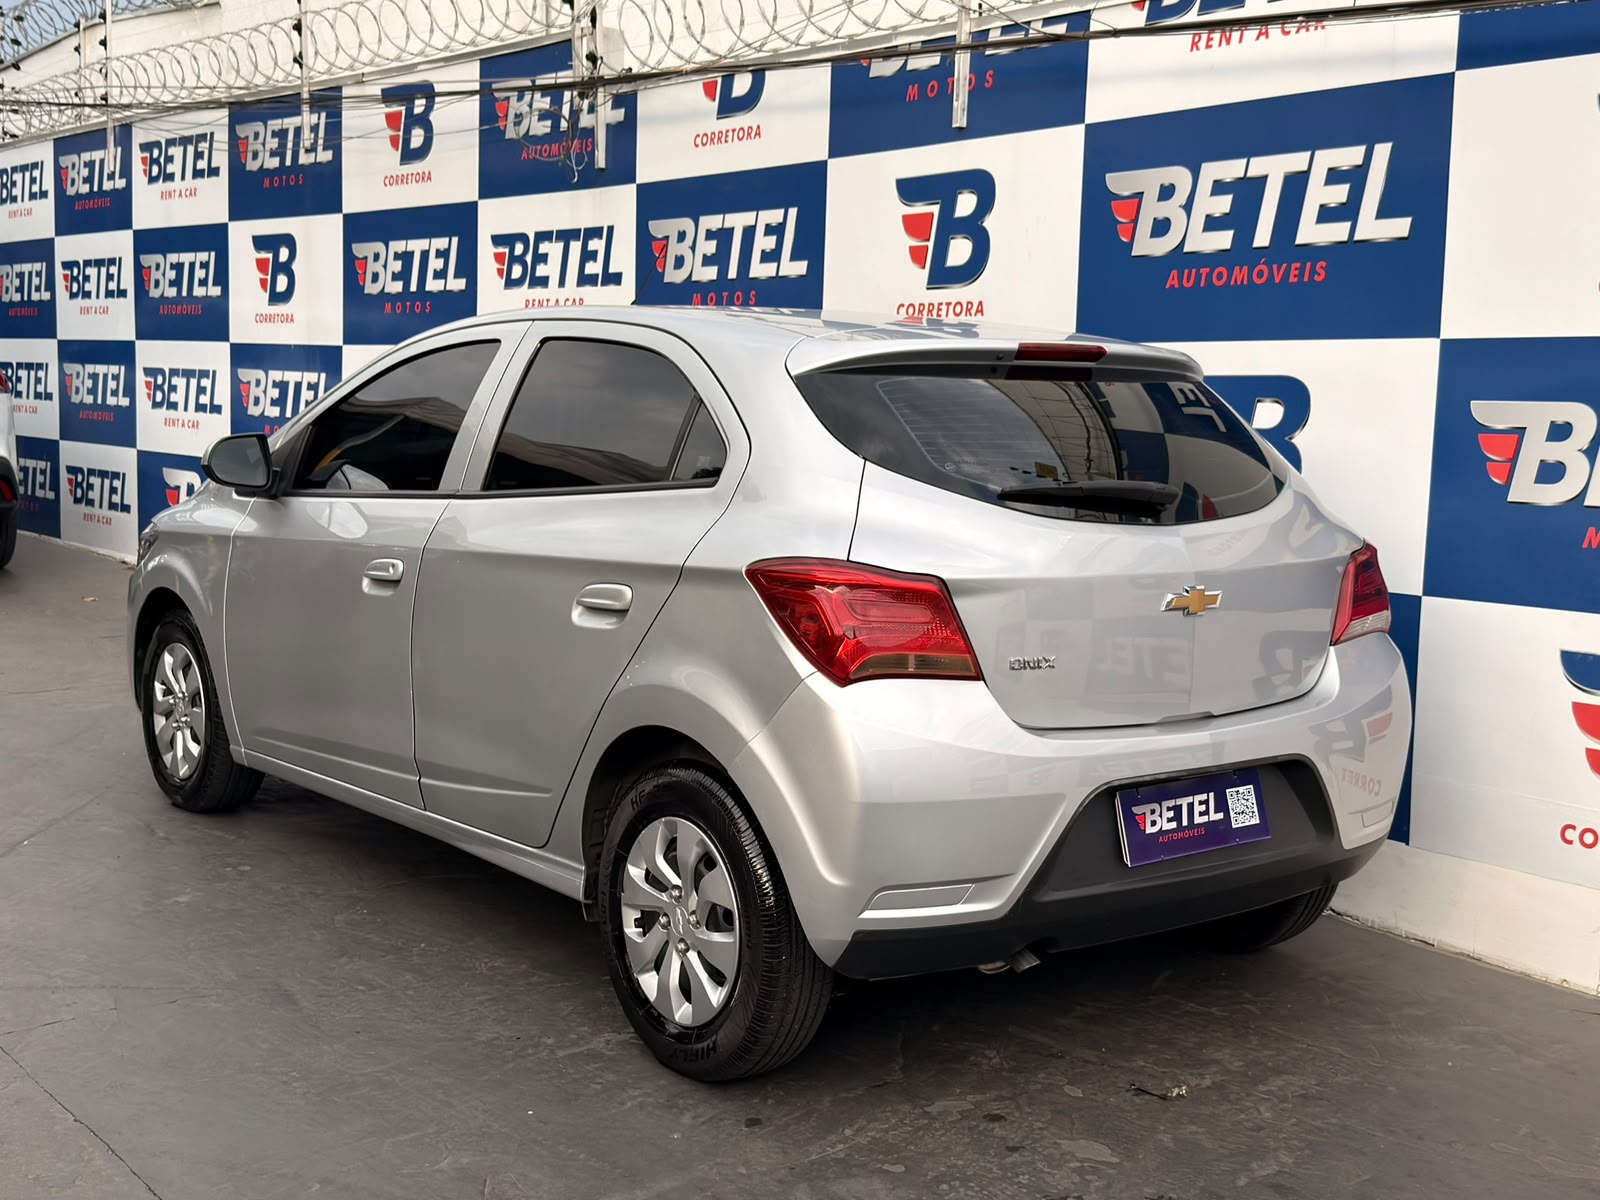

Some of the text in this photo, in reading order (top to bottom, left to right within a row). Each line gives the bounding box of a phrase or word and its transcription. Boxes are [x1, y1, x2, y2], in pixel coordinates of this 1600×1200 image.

[1190, 27, 1248, 52] RENT
[235, 112, 333, 172] BETEL
[693, 124, 761, 148] CORRETORA
[139, 131, 221, 186] BETEL
[0, 160, 49, 206] BETEL
[263, 174, 304, 188] MOTOS
[383, 170, 432, 187] CORRETORA
[160, 187, 198, 200] RENT A CAR
[1105, 141, 1413, 259] BETEL
[8, 209, 20, 219] RENT
[24, 207, 33, 217] CAR
[490, 225, 624, 290] BETEL
[648, 206, 809, 284] BETEL
[61, 257, 128, 300] BETEL
[139, 251, 222, 298] BETEL
[352, 236, 467, 294] BETEL
[1165, 258, 1328, 290] AUTOMÓVEIS
[0, 262, 51, 303] BETEL
[80, 305, 109, 316] RENT A CAR
[384, 301, 431, 314] MOTOS
[692, 290, 756, 306] MOTOS
[896, 300, 984, 318] CORRETORA
[255, 313, 295, 324] CORRETORA
[63, 363, 130, 407] BETEL
[143, 366, 223, 416] BETEL
[164, 417, 200, 430] RENT A CAR
[65, 464, 131, 514] BETEL
[83, 514, 112, 526] RENT A CAR
[1009, 656, 1056, 670] ONIX
[1131, 791, 1224, 834] BETEL
[1158, 827, 1206, 843] AUTOMÓVEIS
